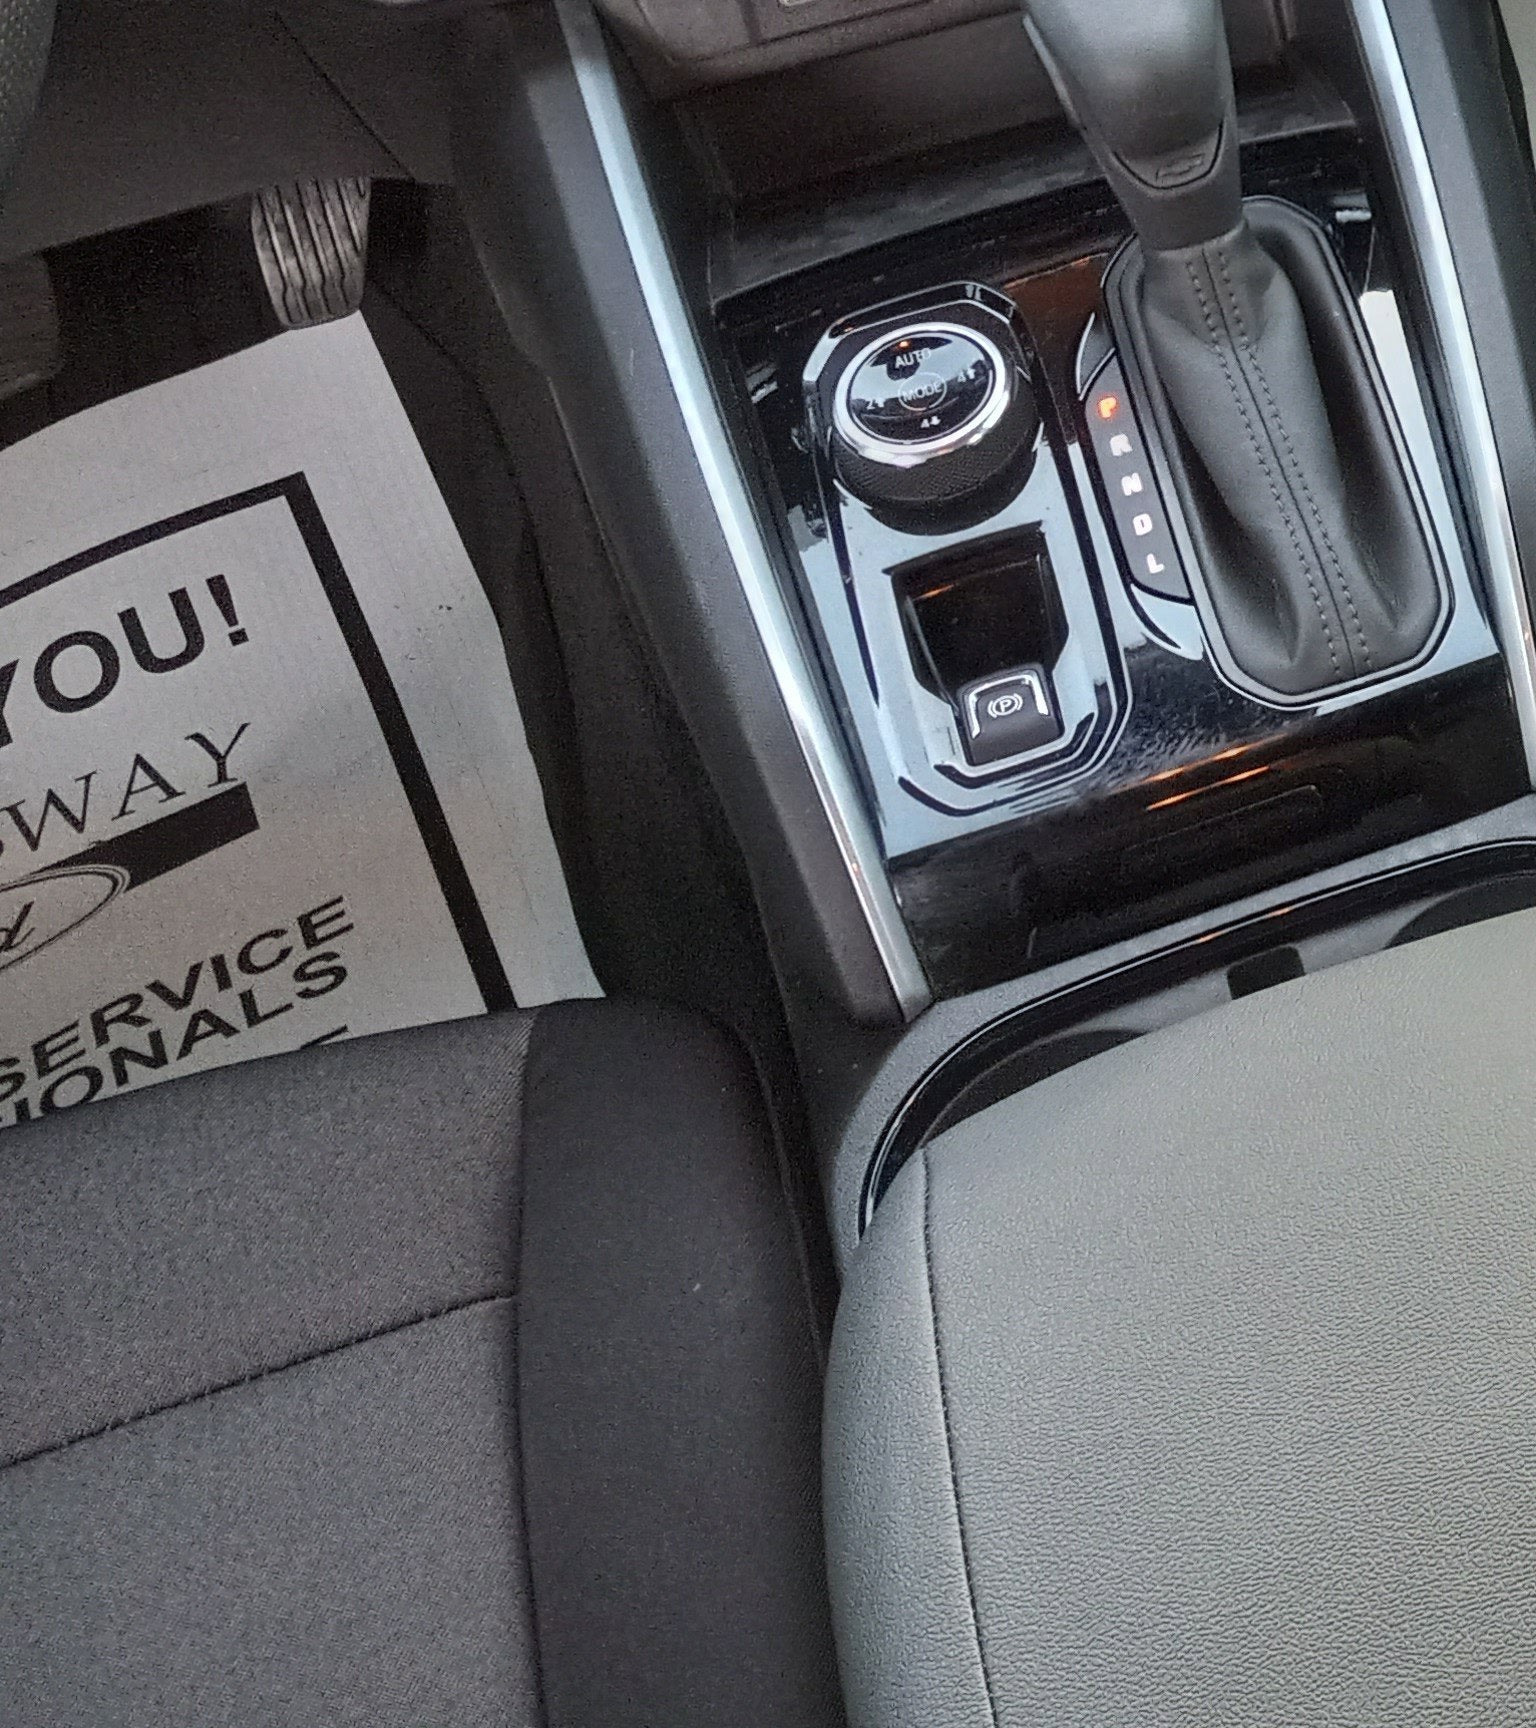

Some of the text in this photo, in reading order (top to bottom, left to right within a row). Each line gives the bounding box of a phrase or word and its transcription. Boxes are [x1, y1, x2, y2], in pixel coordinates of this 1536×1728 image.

[894, 347, 932, 370] AUTO
[901, 379, 944, 404] MODE
[1099, 395, 1118, 419] P
[1109, 433, 1133, 457] R
[1121, 472, 1144, 497] N
[1132, 513, 1153, 536] D
[1146, 552, 1165, 575] L
[0, 574, 250, 749] OU!
[0, 722, 251, 859] WAY
[0, 950, 349, 1124] IONALS
